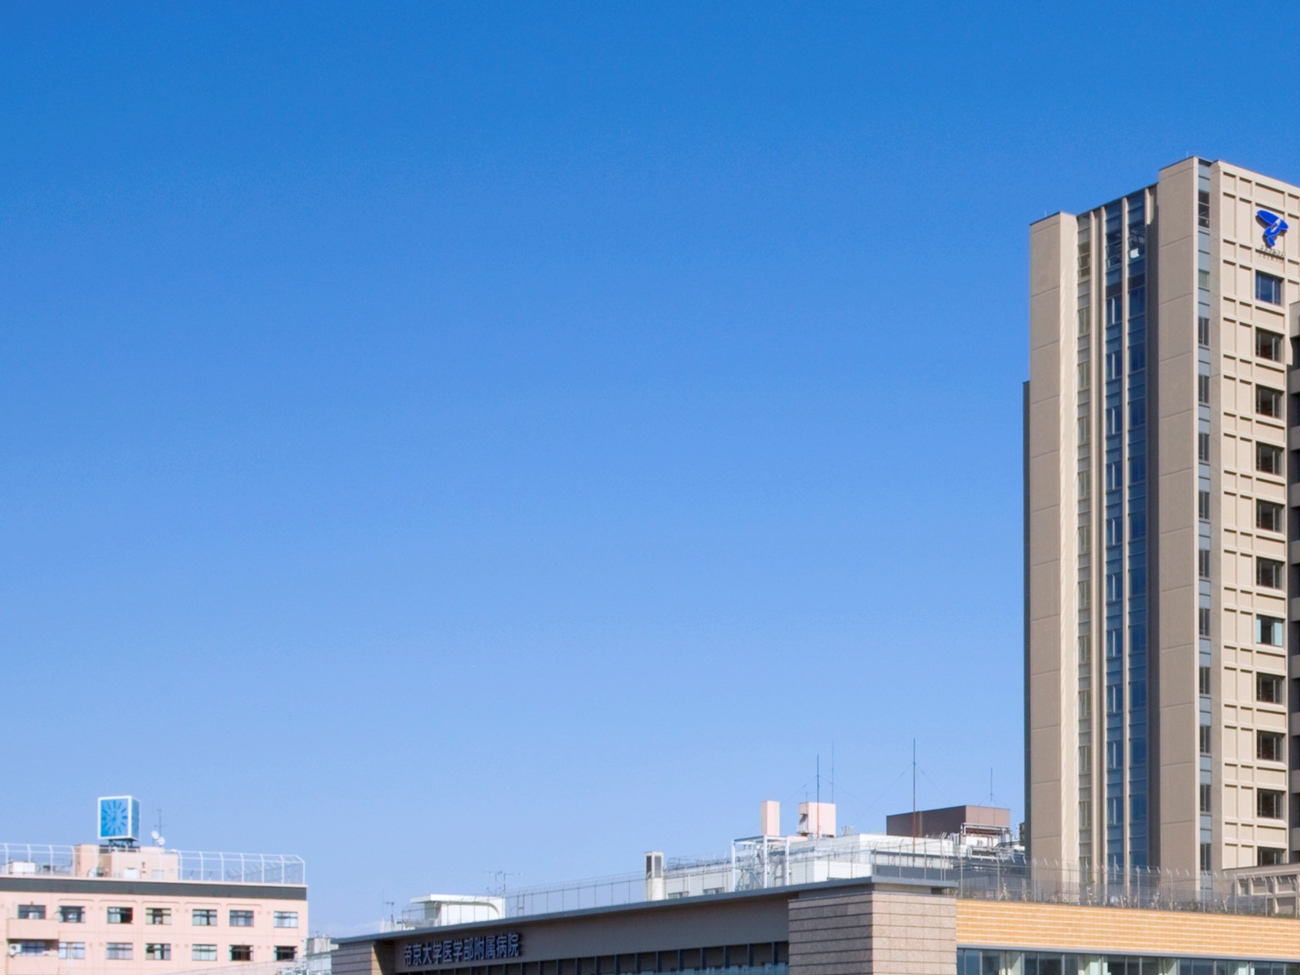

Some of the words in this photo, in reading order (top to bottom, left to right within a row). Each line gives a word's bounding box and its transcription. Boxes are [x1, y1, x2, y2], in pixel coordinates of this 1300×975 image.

[404, 933, 519, 966] 帝京大学医学部附属病院
